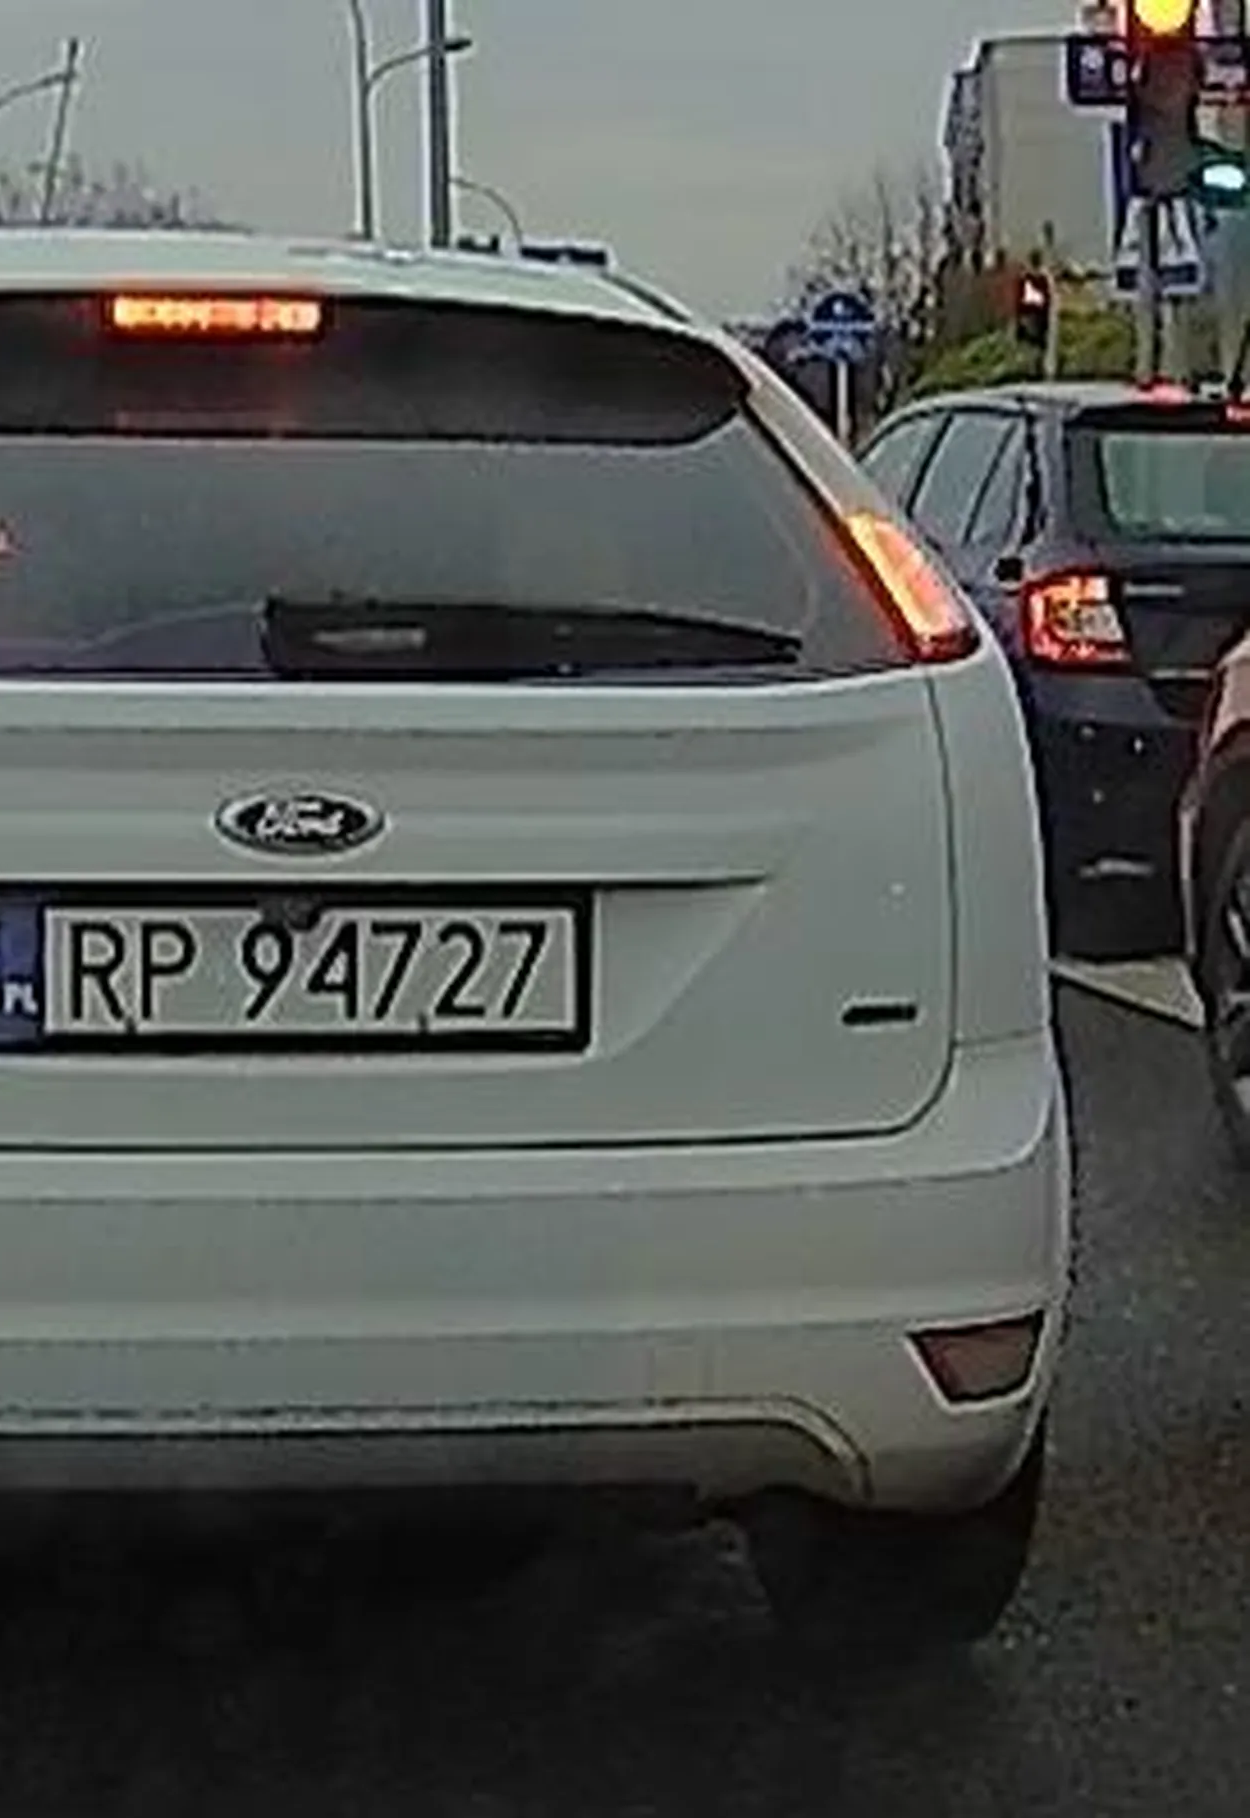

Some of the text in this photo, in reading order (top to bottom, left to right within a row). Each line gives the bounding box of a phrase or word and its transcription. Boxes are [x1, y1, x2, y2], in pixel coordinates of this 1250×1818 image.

[257, 801, 345, 840] Ford
[70, 920, 548, 1019] RP 94727
[3, 981, 39, 1014] PL
